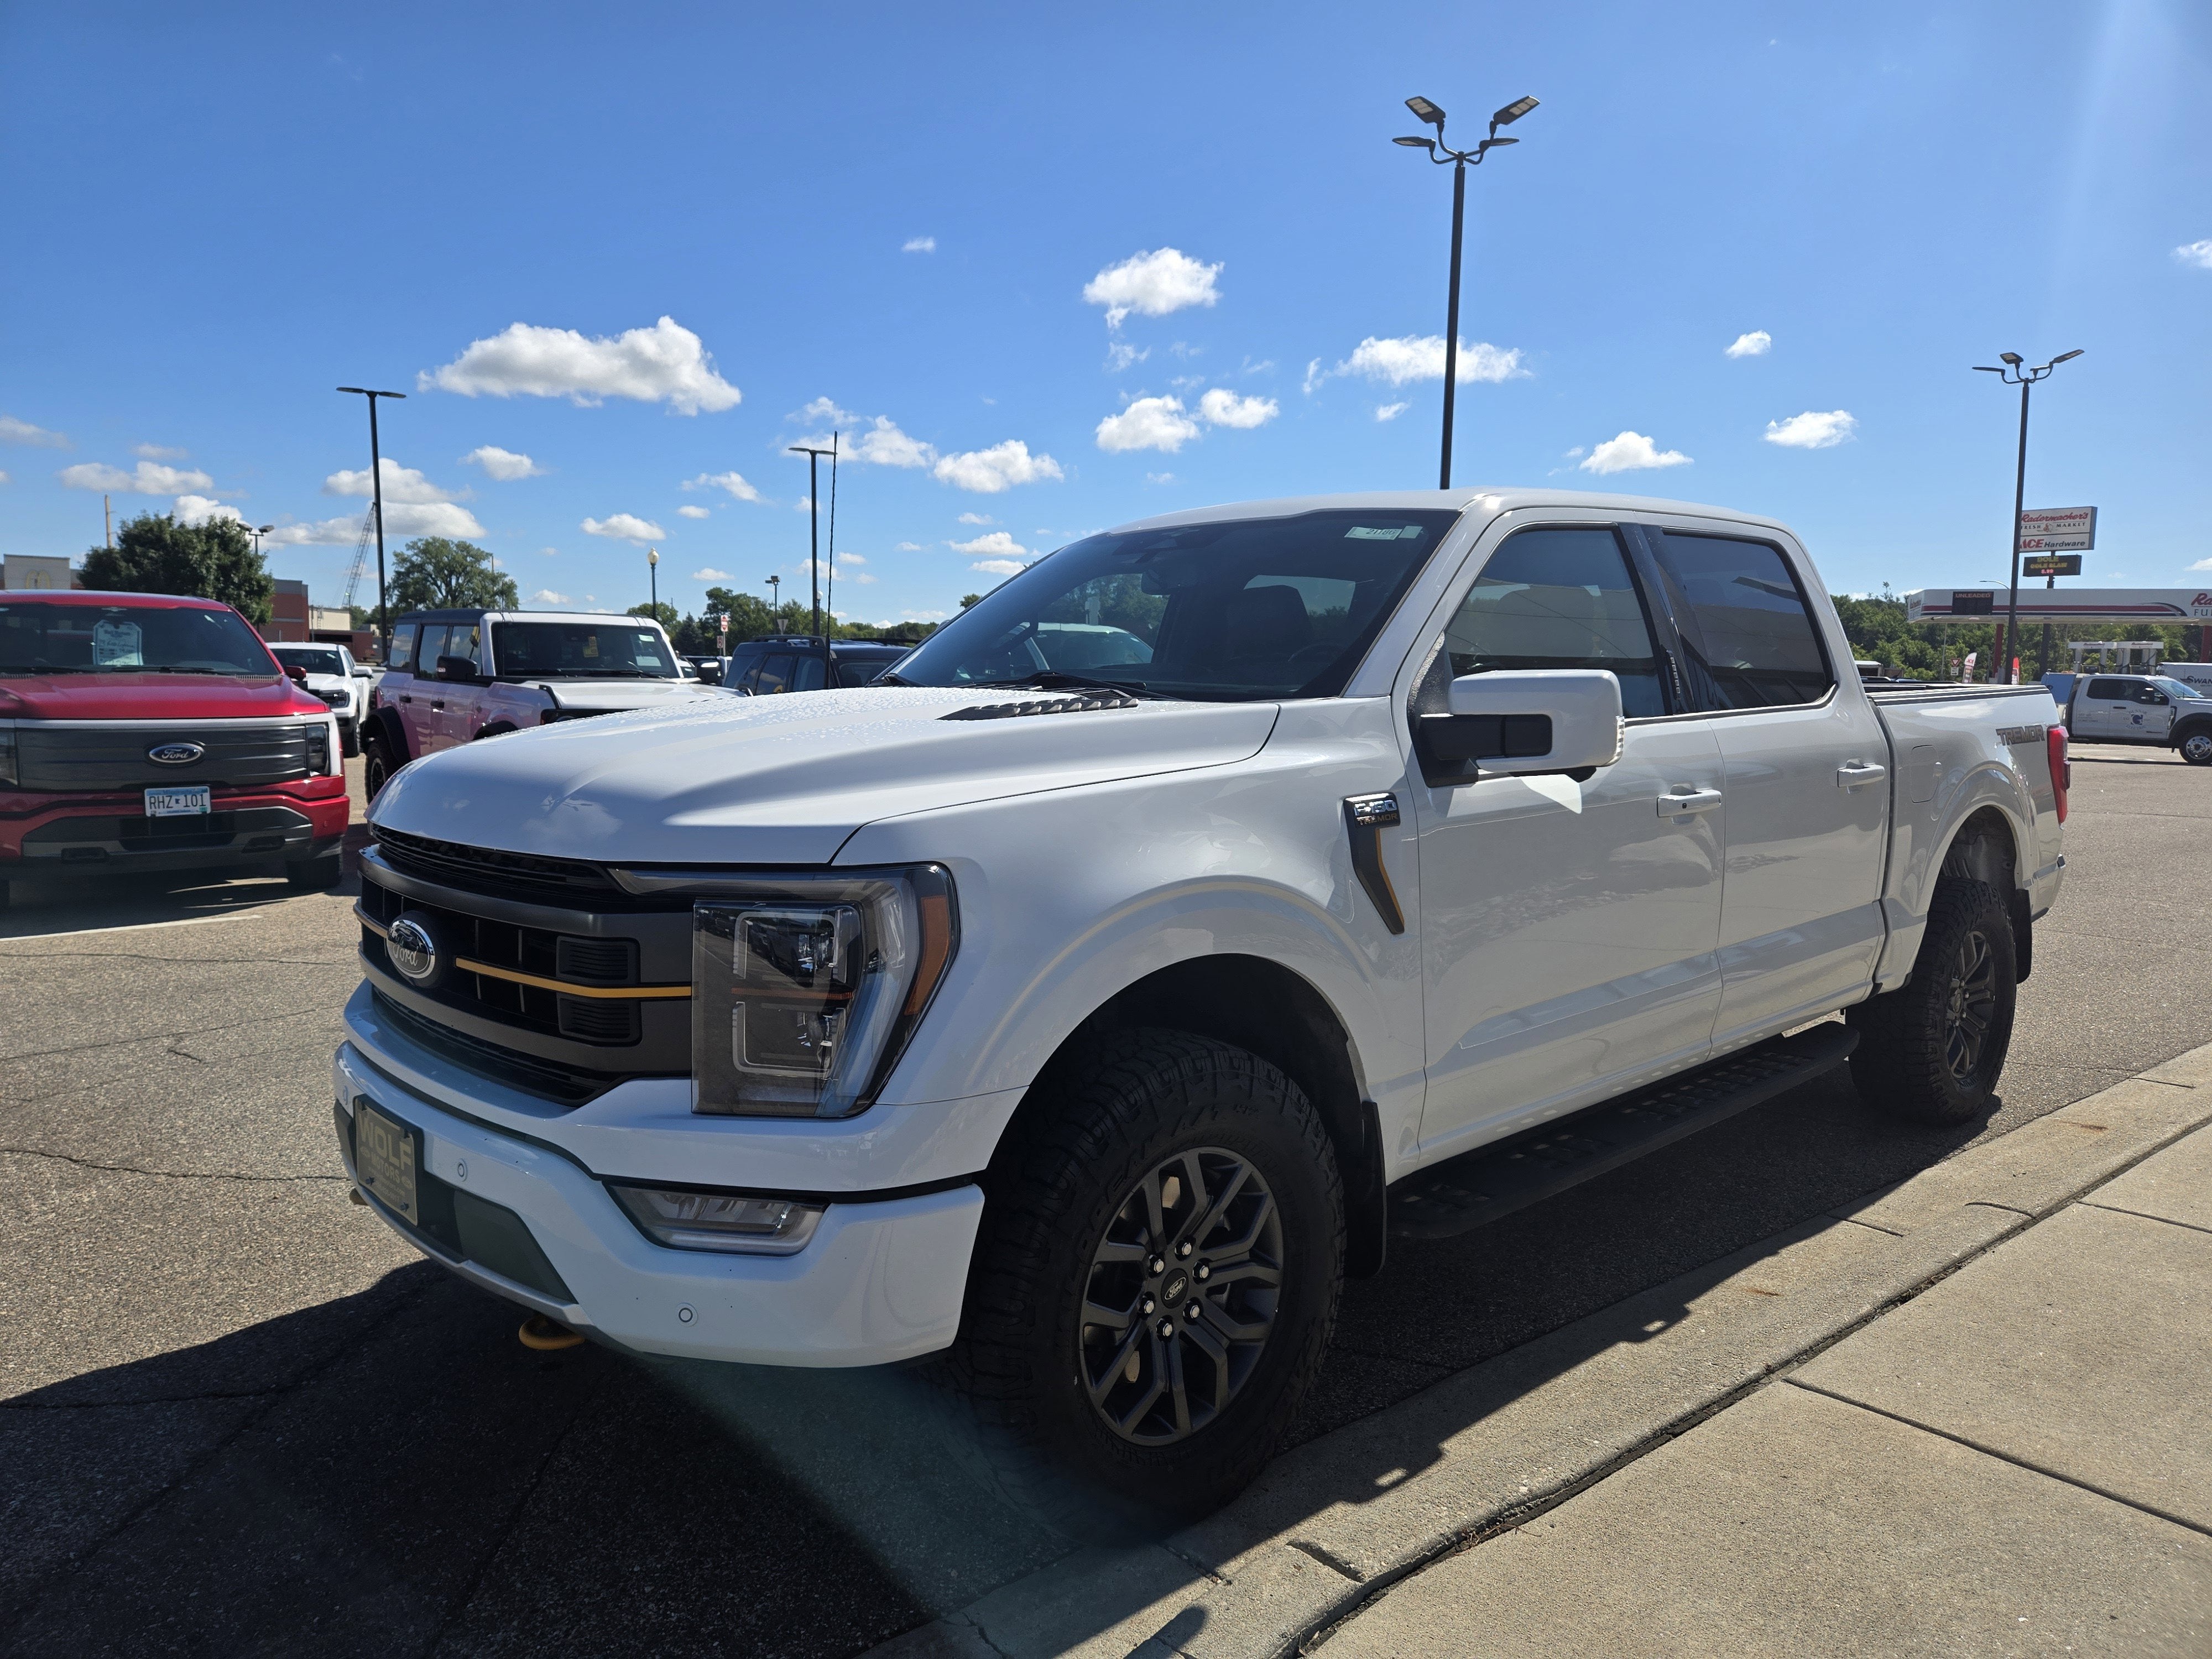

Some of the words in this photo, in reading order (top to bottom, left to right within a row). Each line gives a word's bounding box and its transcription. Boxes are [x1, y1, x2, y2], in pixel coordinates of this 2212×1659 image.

[2021, 512, 2089, 523] Radermacher's
[2020, 539, 2044, 549] ACE
[1996, 724, 2045, 745] TREMOR
[161, 749, 189, 759] Ford
[149, 796, 173, 809] RHZ
[183, 794, 206, 807] 101
[359, 1113, 411, 1171] WOLF
[372, 1152, 400, 1184] MOTORS
[1169, 1280, 1182, 1297] Ford
